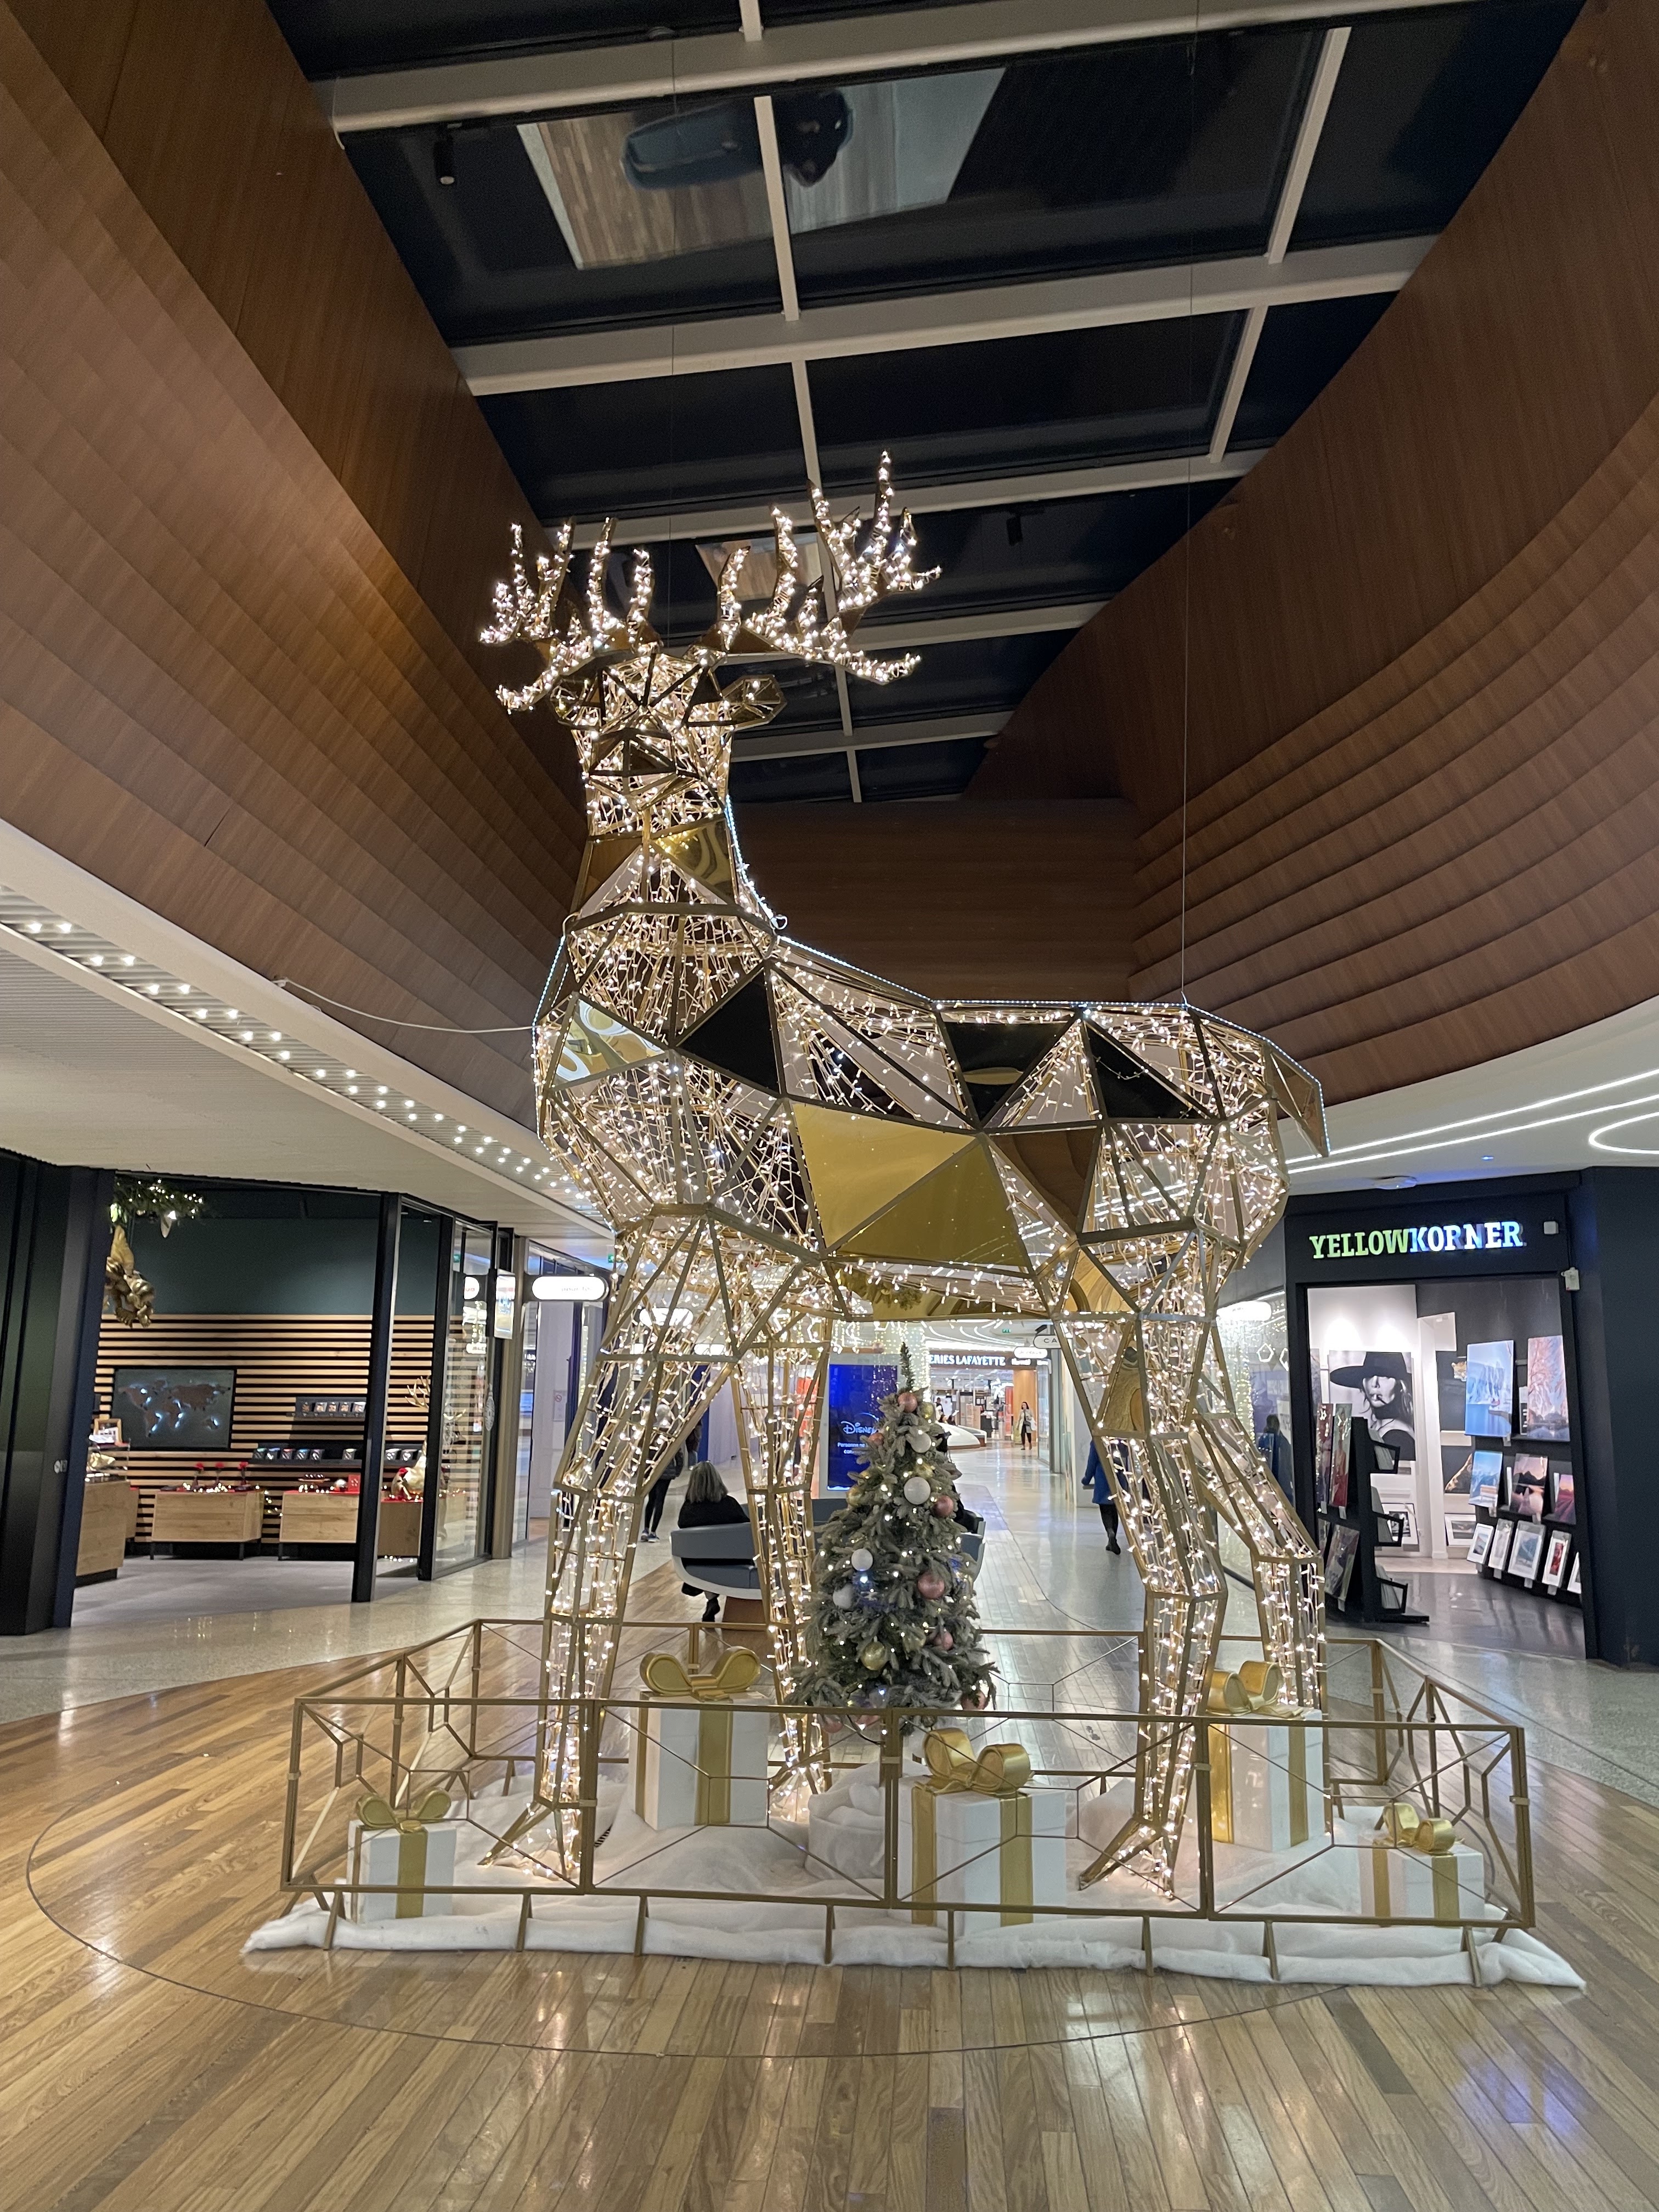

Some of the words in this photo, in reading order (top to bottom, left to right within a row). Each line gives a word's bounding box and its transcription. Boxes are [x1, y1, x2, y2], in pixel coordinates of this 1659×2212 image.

[1309, 1221, 1524, 1259] YELLOWKORNER
[929, 1354, 955, 1365] ERIES
[955, 1355, 1006, 1367] LAFAYETTE
